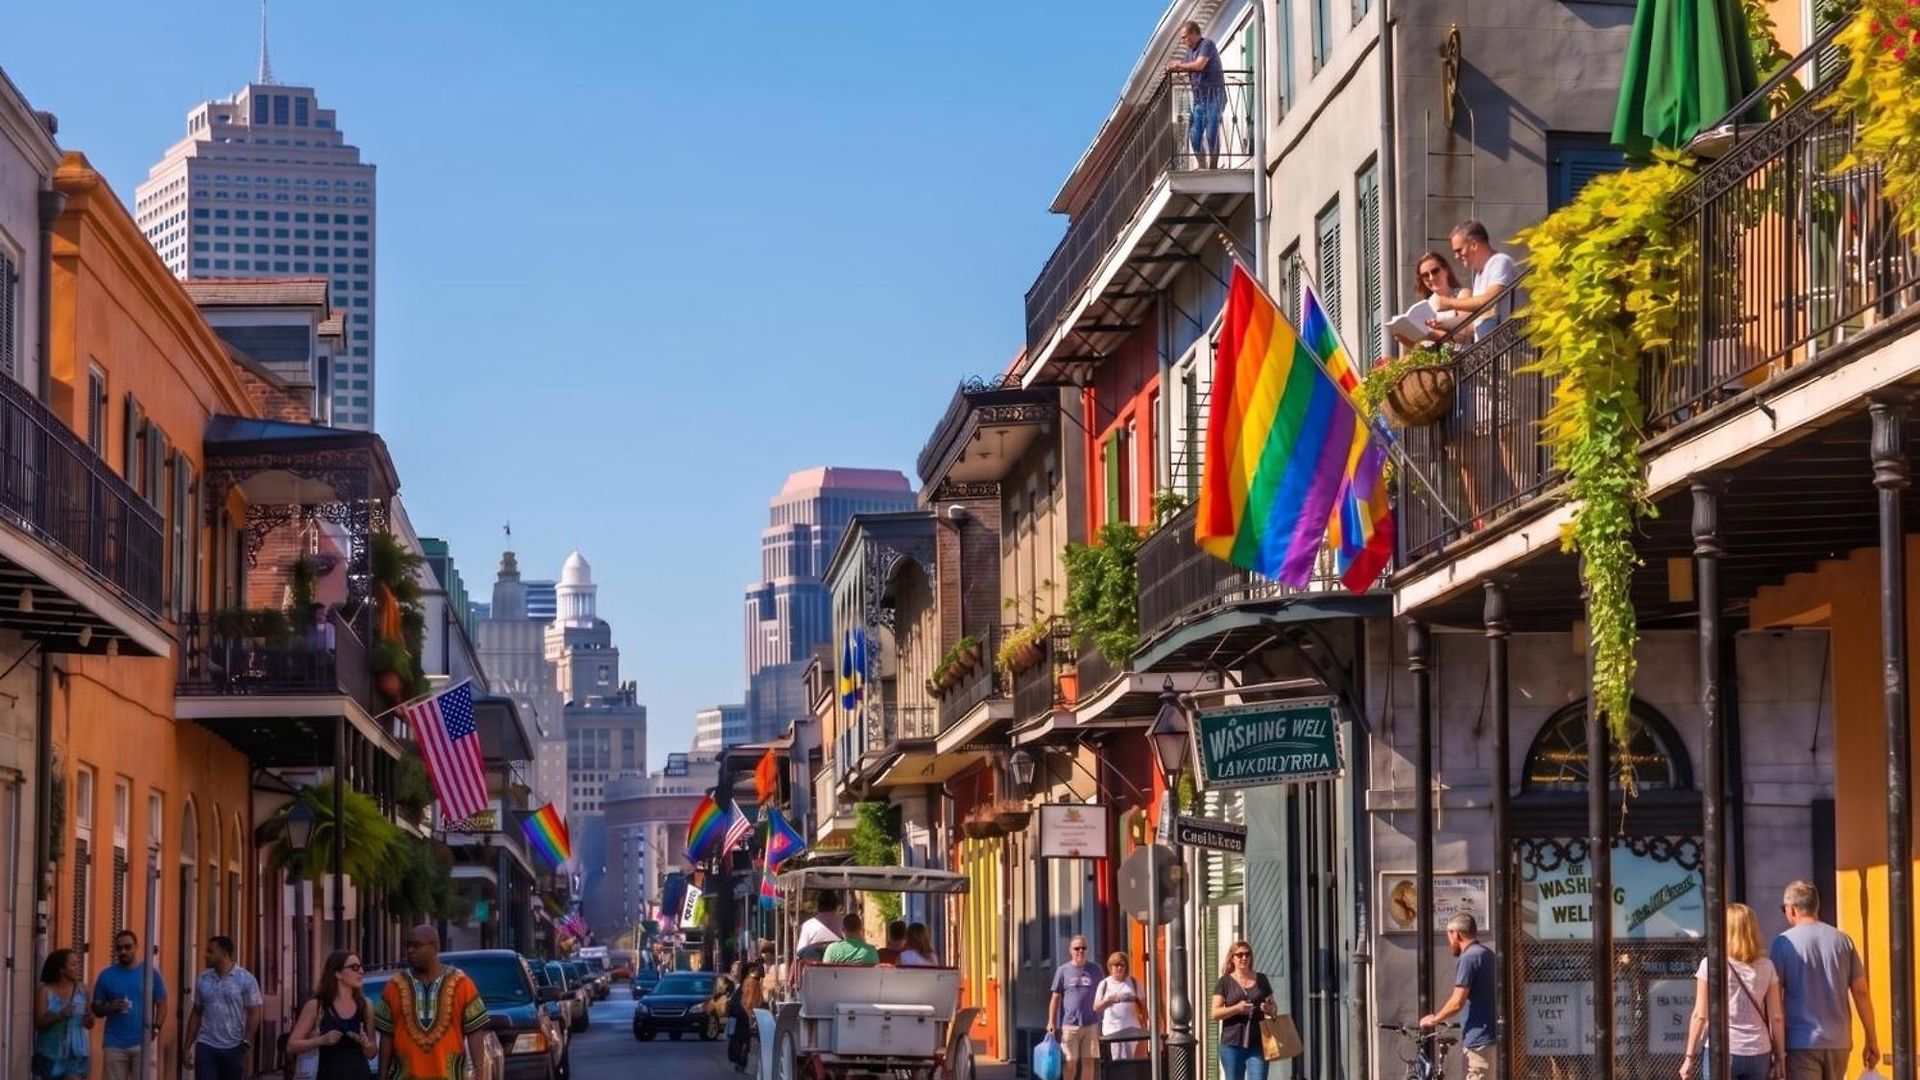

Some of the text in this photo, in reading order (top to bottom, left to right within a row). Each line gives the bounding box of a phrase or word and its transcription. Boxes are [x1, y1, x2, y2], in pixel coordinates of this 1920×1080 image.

[1209, 717, 1327, 762] WASHING WELL
[1539, 877, 1625, 905] WASHIG
